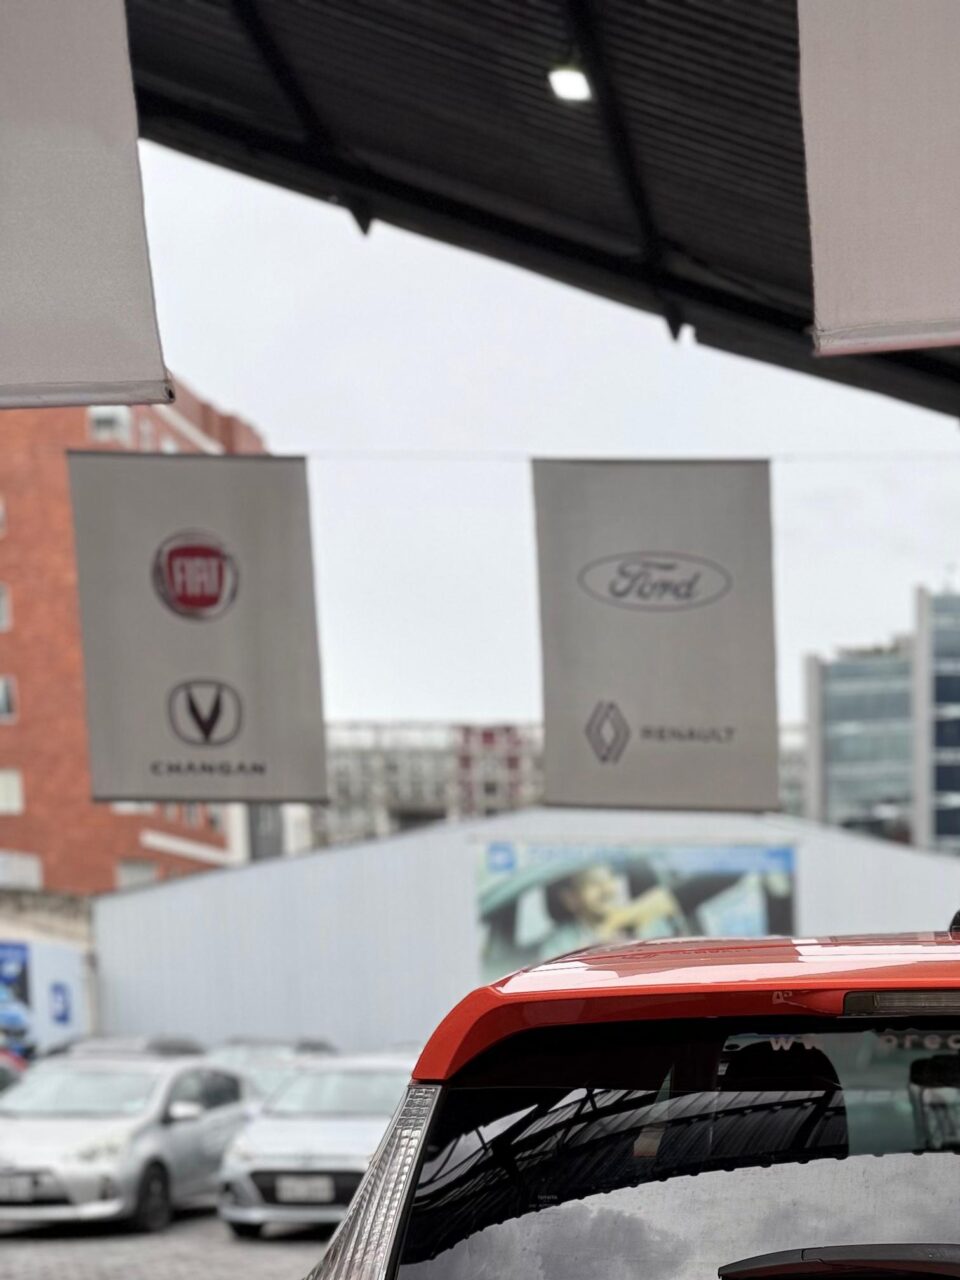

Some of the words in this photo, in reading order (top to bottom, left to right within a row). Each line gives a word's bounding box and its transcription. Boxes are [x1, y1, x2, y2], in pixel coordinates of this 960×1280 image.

[173, 556, 221, 596] FIAT
[609, 561, 700, 599] Ford
[640, 726, 735, 743] RENAULT
[151, 761, 267, 776] CHANGAN
